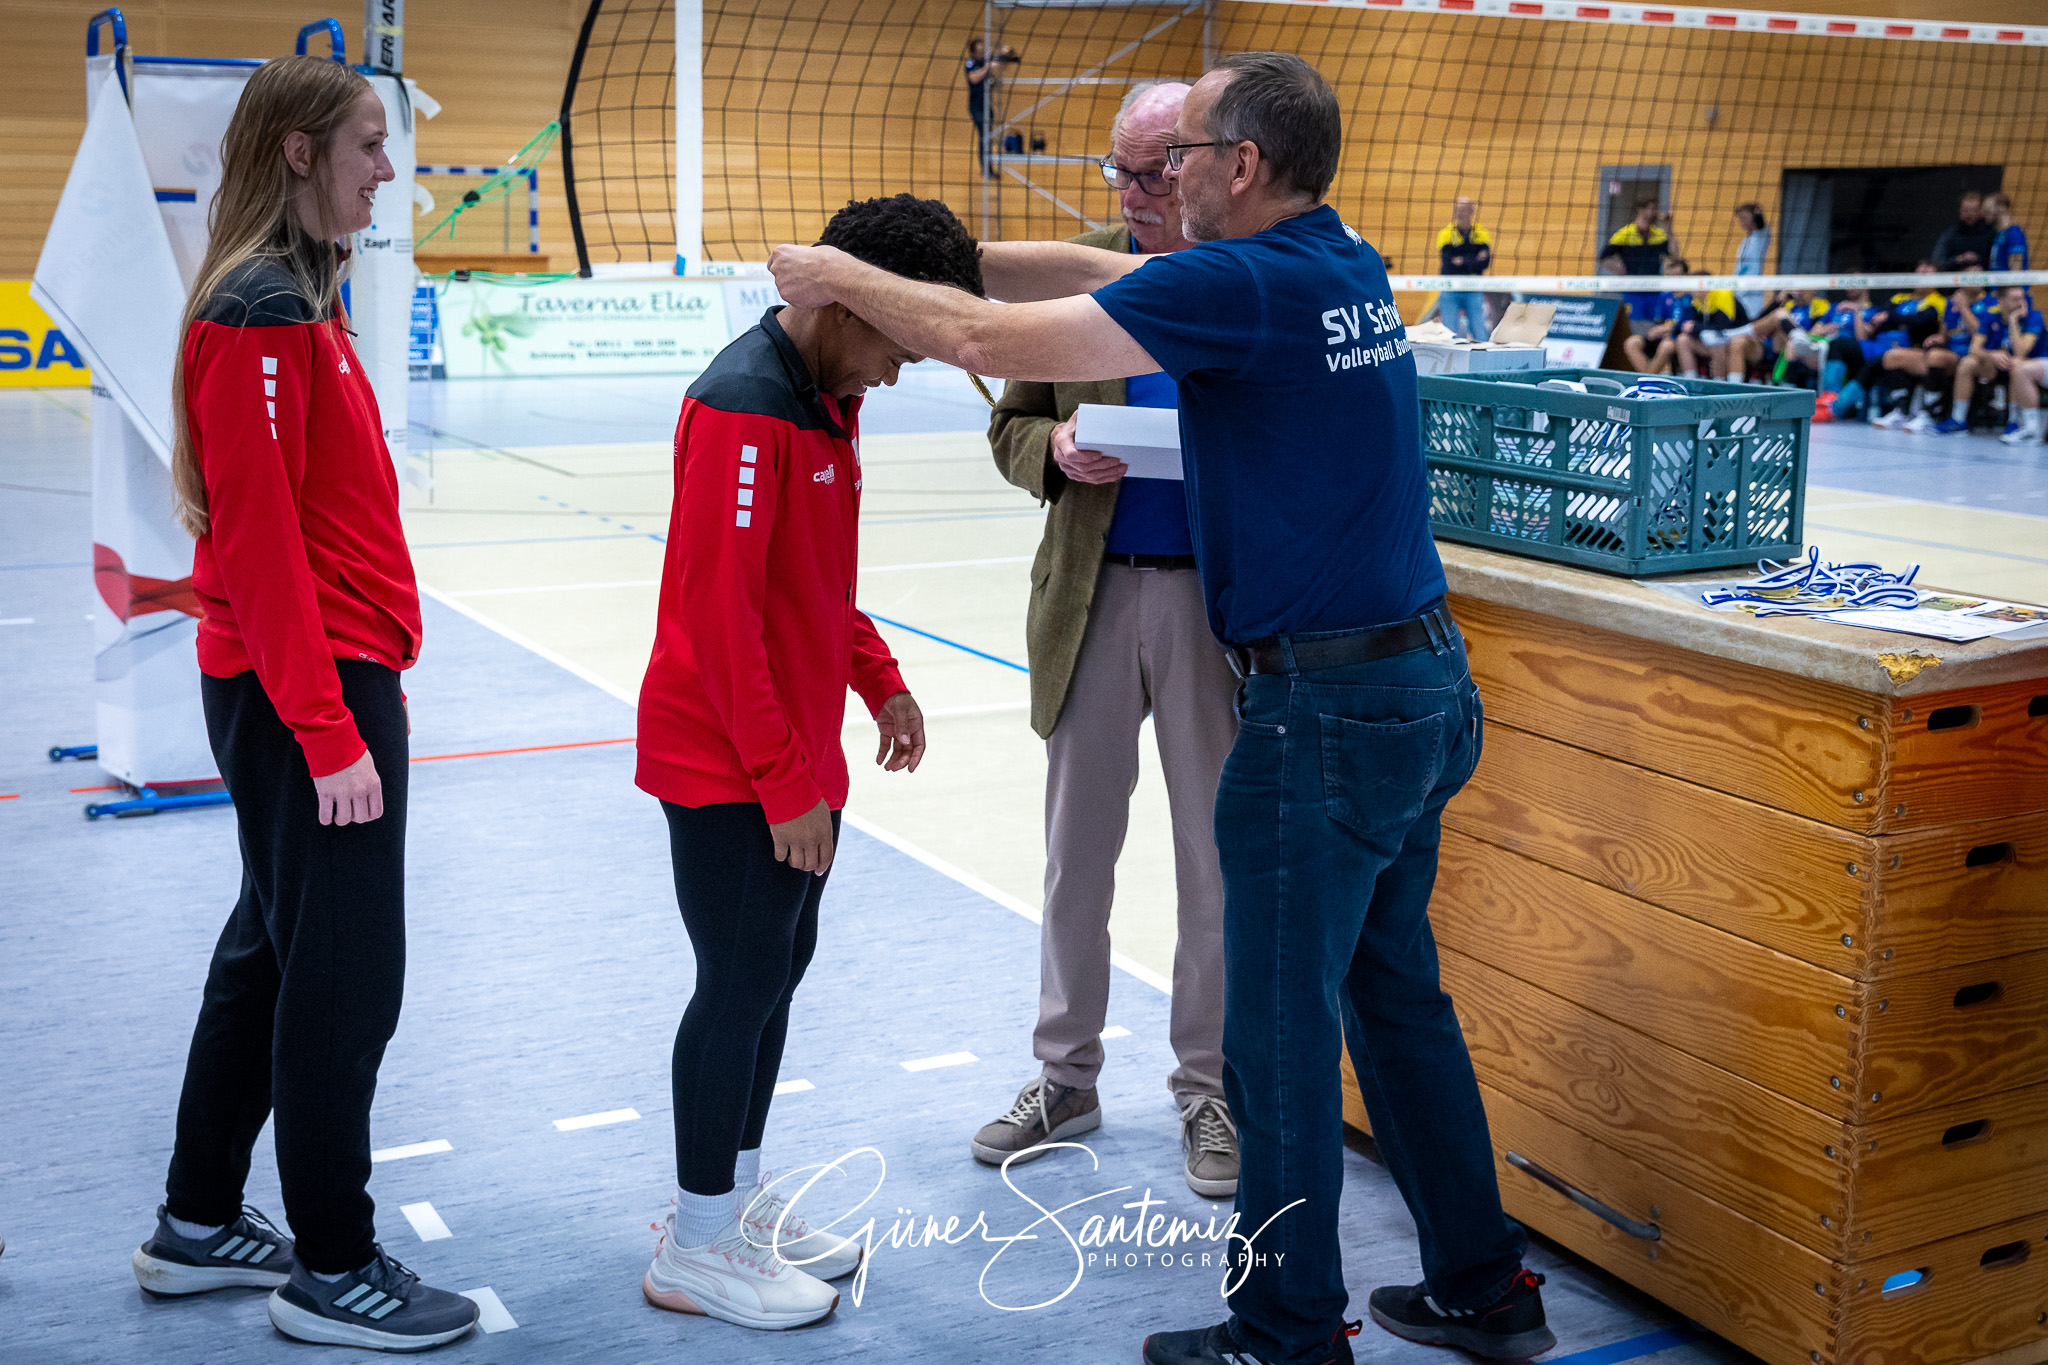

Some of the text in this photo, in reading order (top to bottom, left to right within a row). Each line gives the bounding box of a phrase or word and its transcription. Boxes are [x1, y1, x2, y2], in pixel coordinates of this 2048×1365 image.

[364, 238, 391, 250] Zapf
[518, 289, 711, 314] Taverna Elia
[1321, 305, 1360, 345] SV
[1325, 340, 1396, 373] Volleyball
